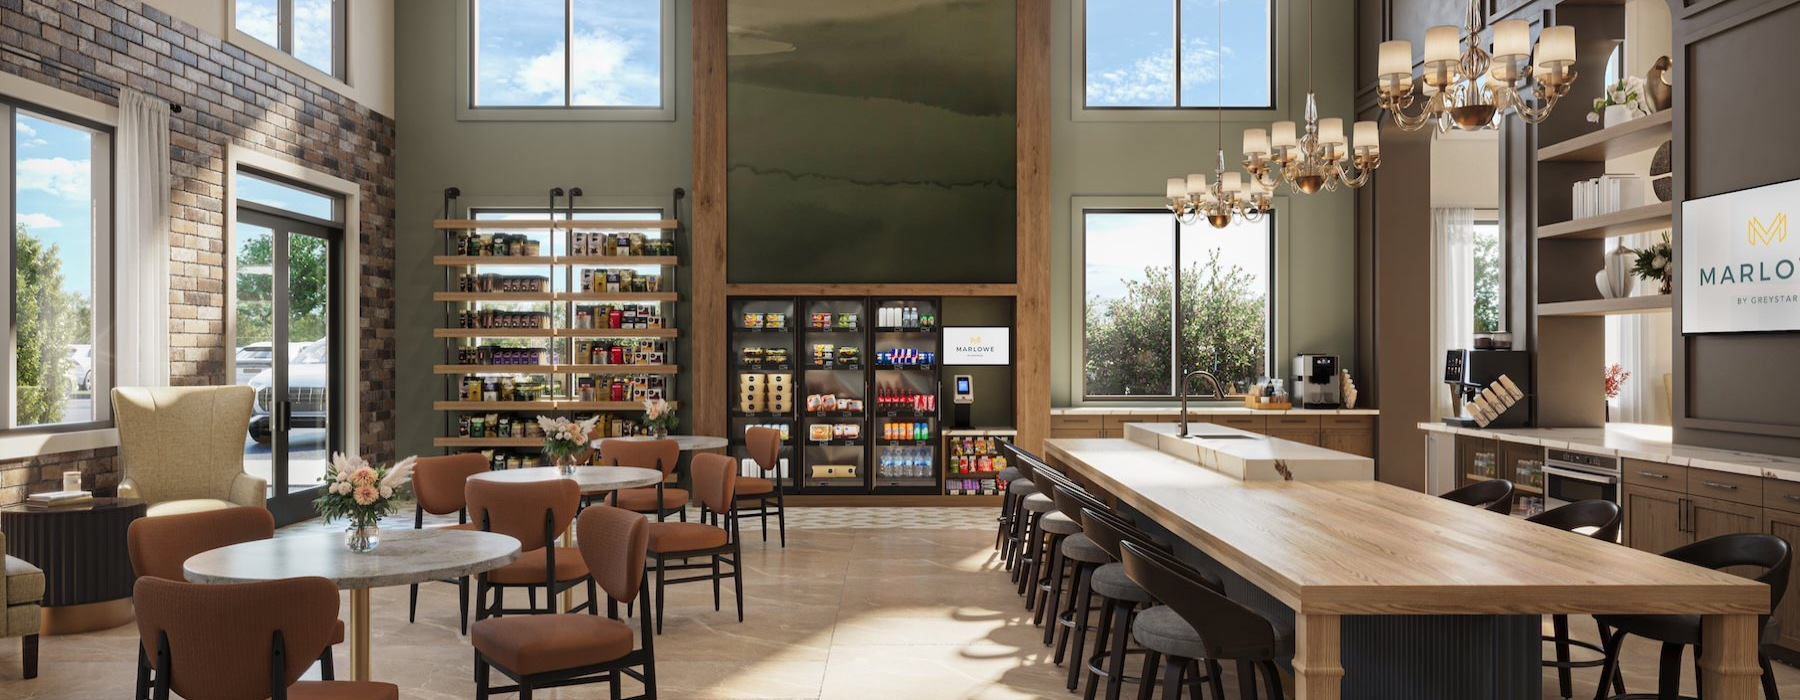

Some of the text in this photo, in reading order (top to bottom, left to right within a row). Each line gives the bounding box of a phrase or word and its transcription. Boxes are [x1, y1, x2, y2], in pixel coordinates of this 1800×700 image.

[1700, 257, 1800, 286] MARLO
[1737, 294, 1798, 305] BY GREYSTAR
